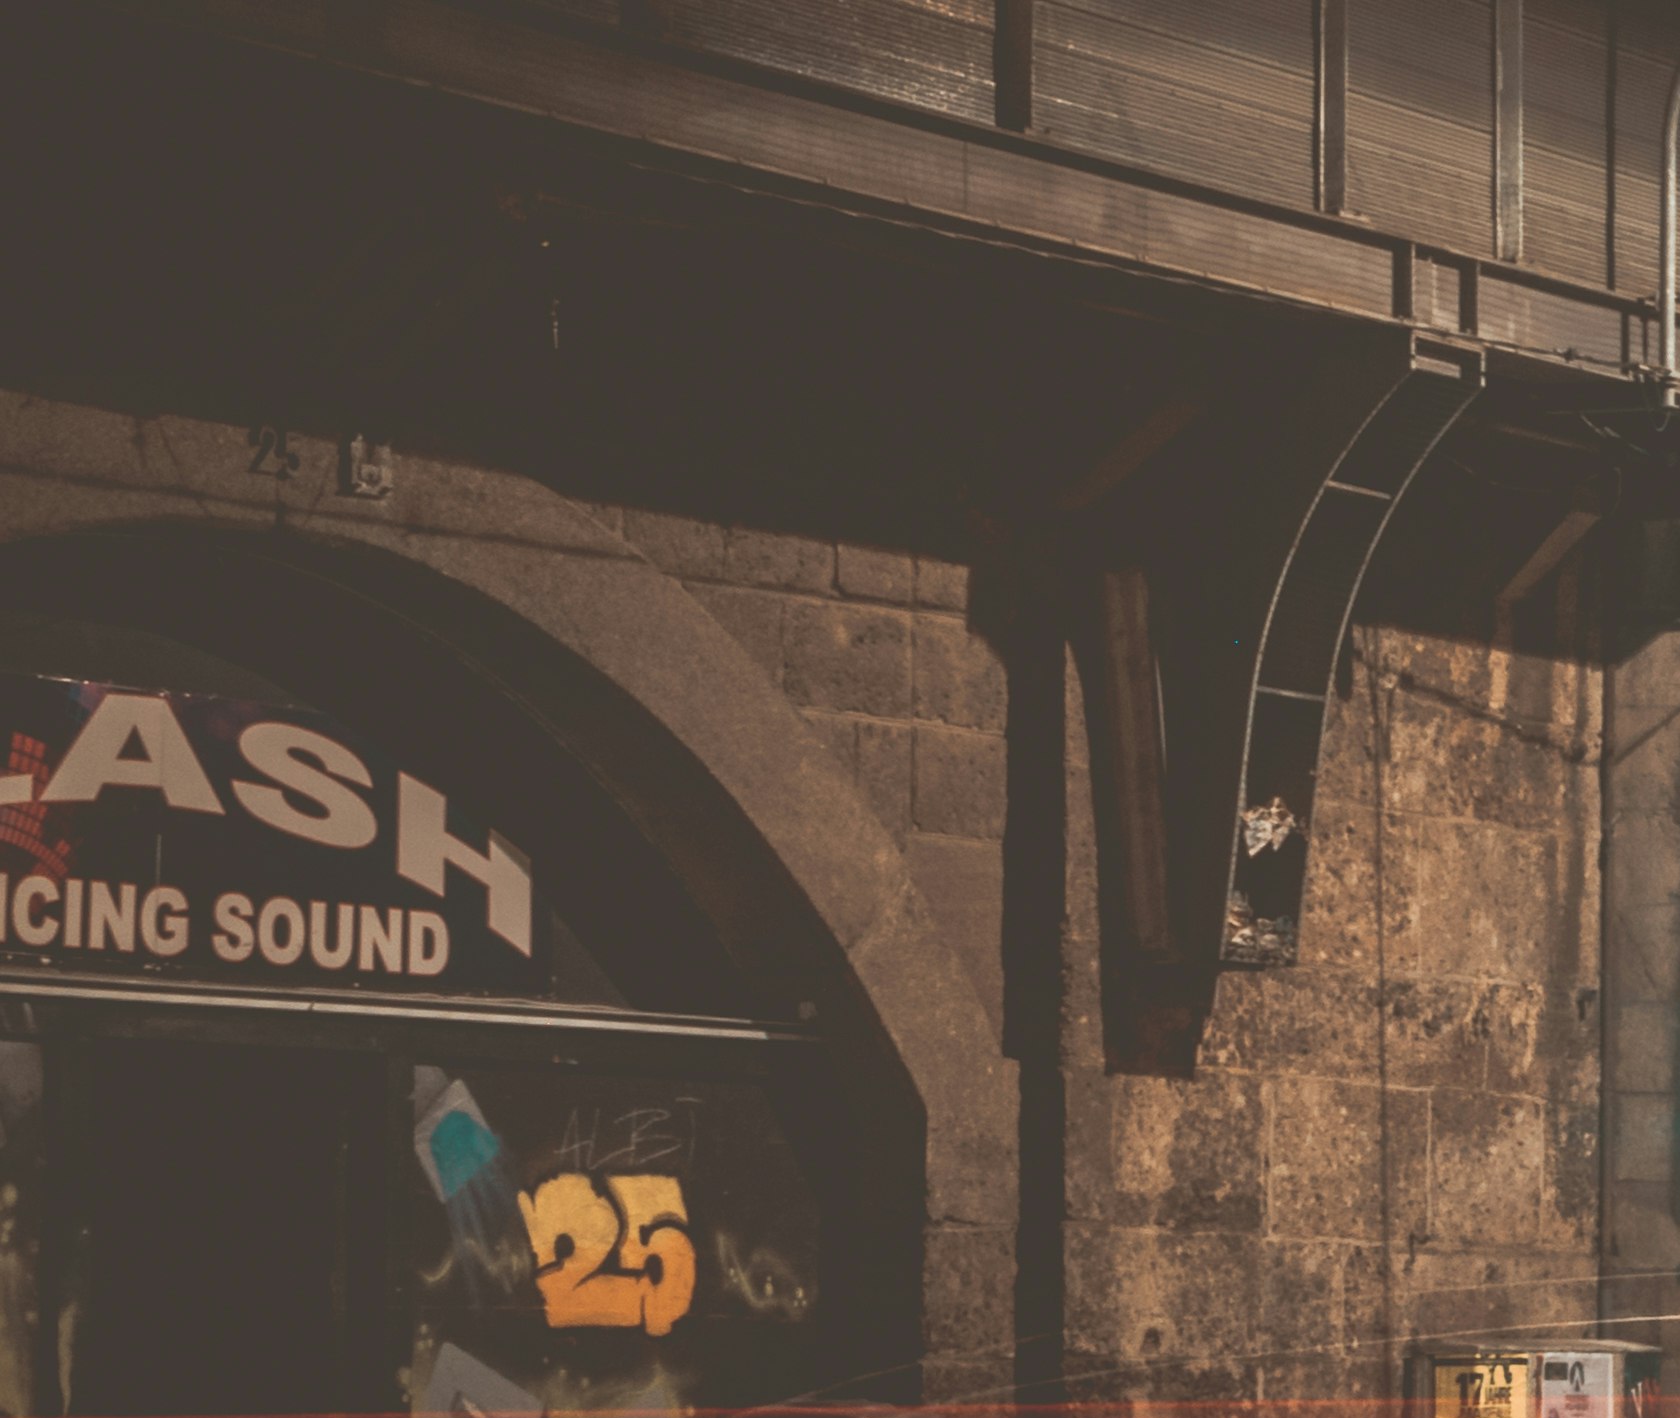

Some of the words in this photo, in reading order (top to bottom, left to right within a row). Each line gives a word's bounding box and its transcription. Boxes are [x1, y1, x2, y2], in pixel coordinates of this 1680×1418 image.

[0, 693, 532, 959] ASH
[212, 892, 450, 977] SOUND
[517, 1172, 697, 1337] 25
